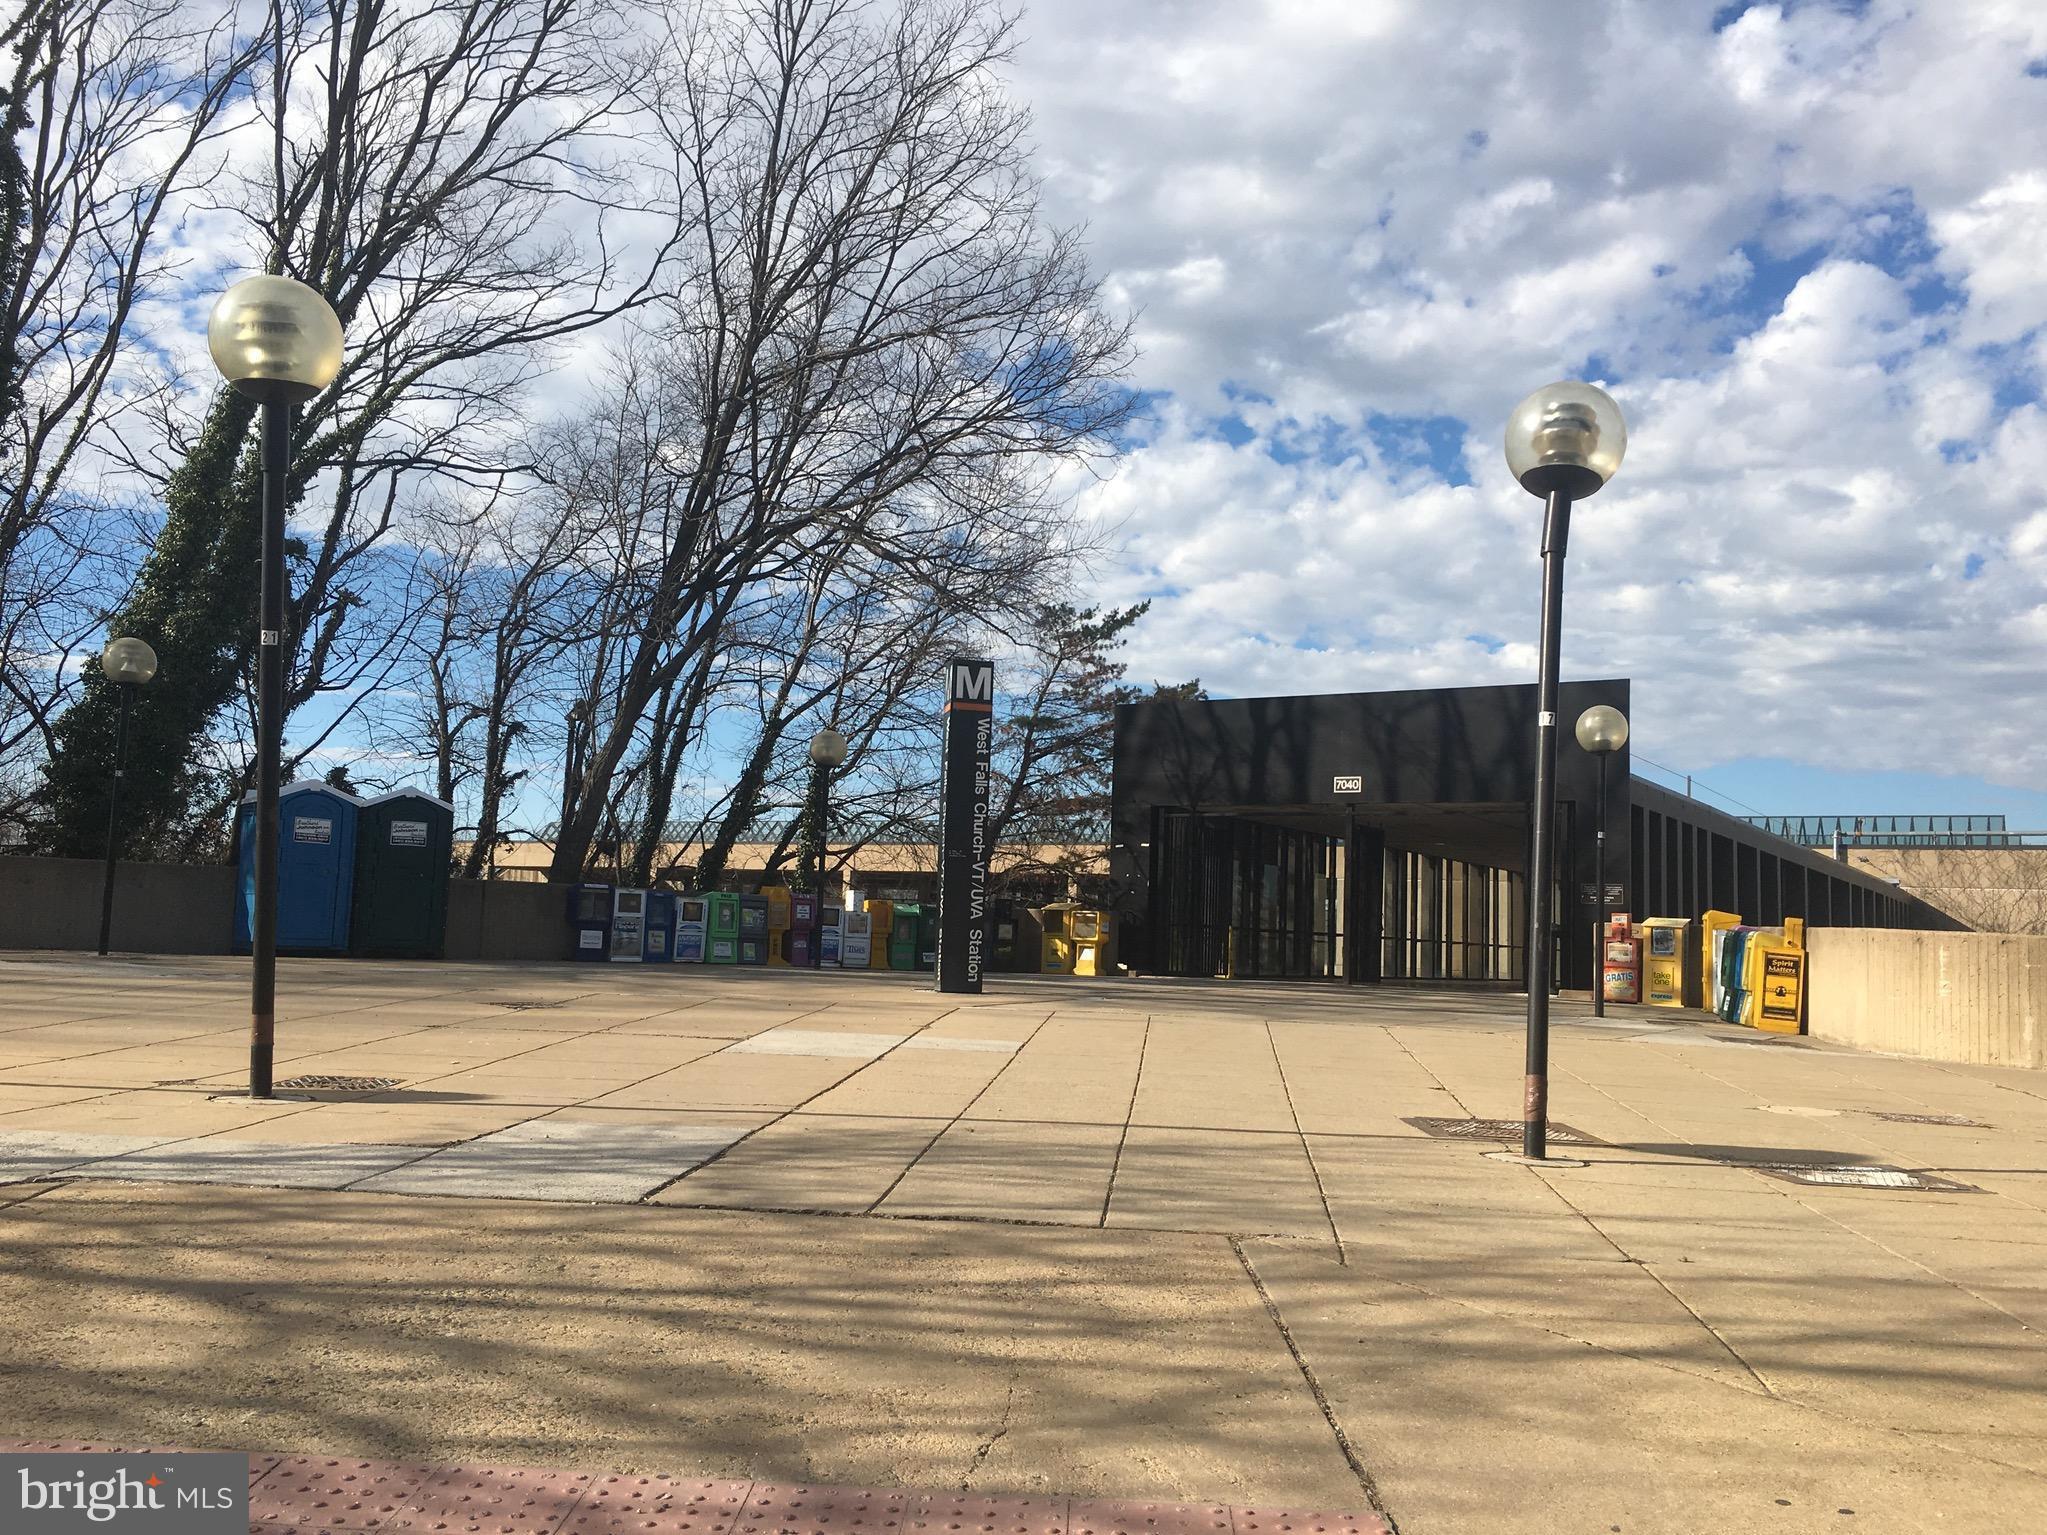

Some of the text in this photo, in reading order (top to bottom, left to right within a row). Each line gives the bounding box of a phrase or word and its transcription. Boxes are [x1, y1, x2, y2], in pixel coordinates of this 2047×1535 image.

[262, 631, 276, 644] 21
[955, 665, 992, 701] M
[1336, 779, 1359, 790] 7040
[967, 718, 990, 982] West Falls Church-VT/UVA Station
[1772, 959, 1794, 968] Spirit
[1653, 971, 1671, 979] take
[1768, 965, 1796, 974] Matters
[1605, 972, 1633, 983] GRATIS
